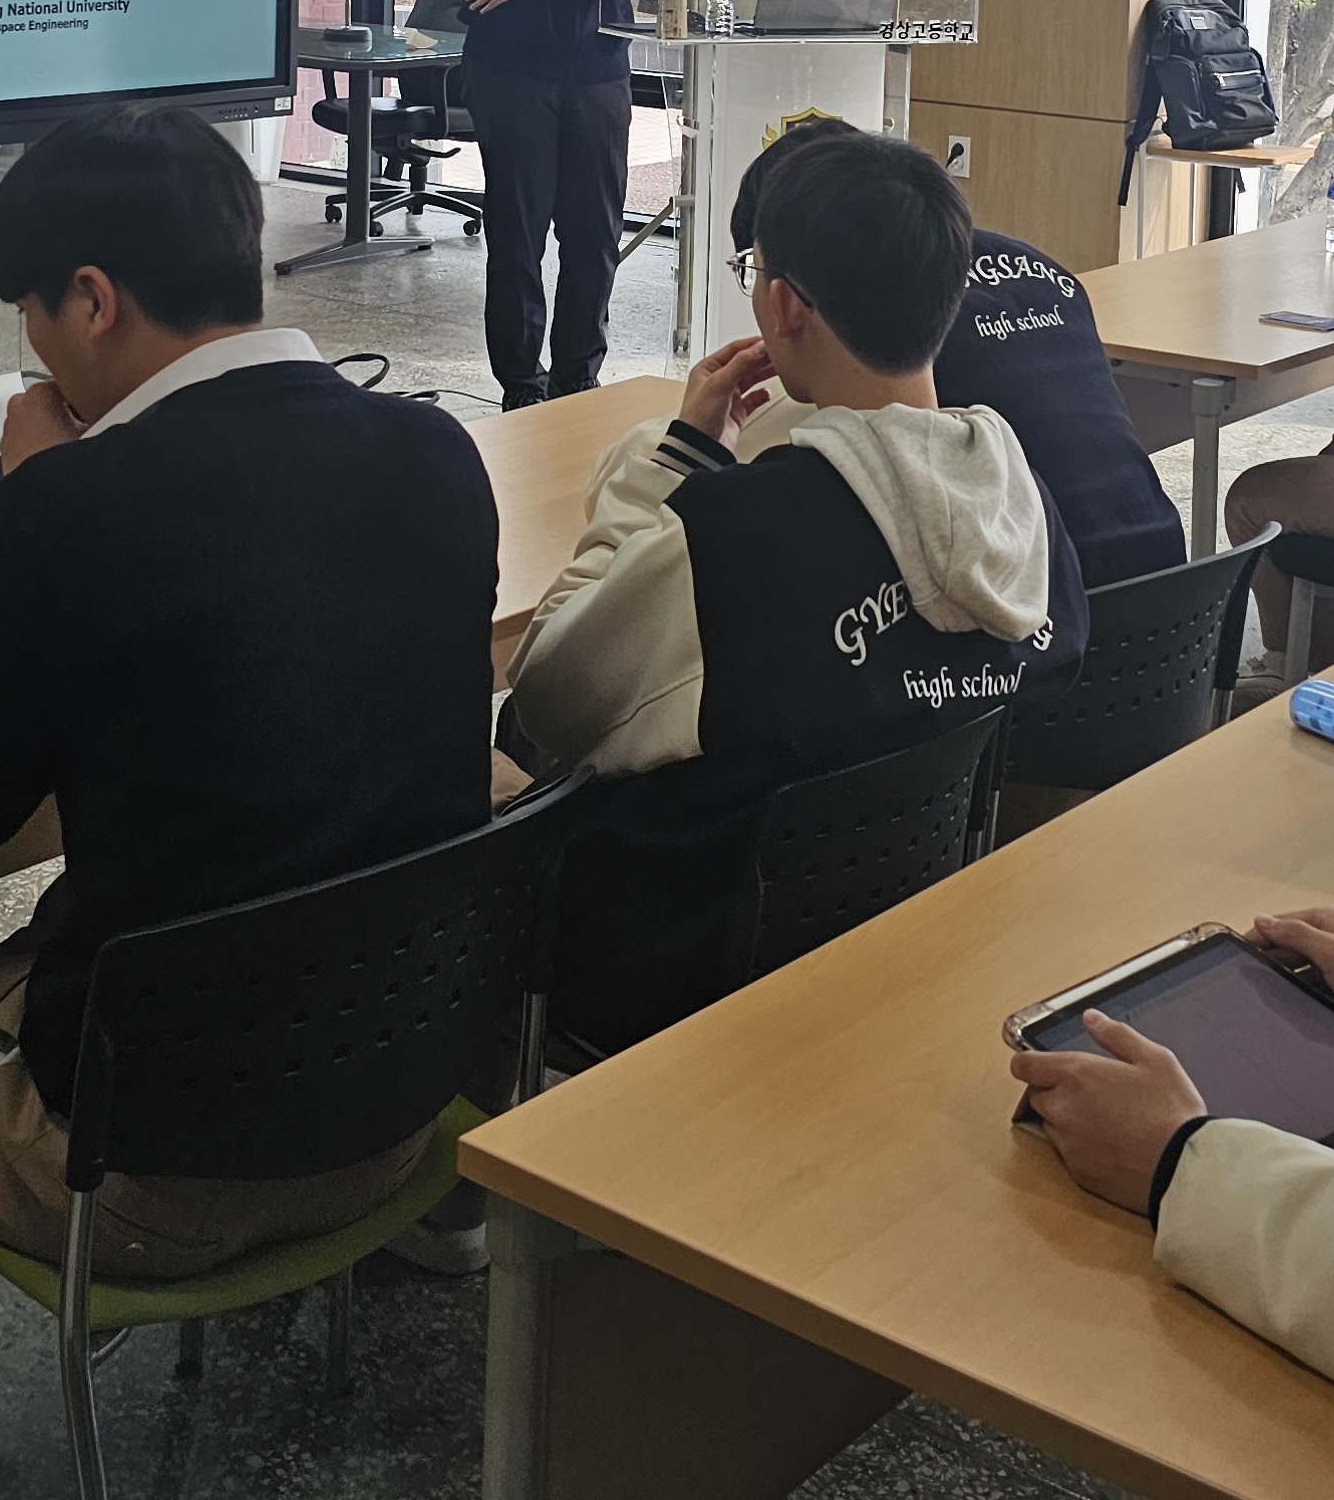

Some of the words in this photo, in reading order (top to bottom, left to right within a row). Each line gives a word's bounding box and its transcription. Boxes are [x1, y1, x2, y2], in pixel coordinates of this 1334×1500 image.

[7, 0, 62, 17] National
[29, 18, 89, 32] Engineering
[879, 21, 973, 41] 경상고등학교
[965, 254, 1075, 298] NGSANG
[975, 311, 1016, 341] high
[1016, 304, 1065, 331] school
[903, 666, 956, 709] high
[962, 661, 1026, 698] school
